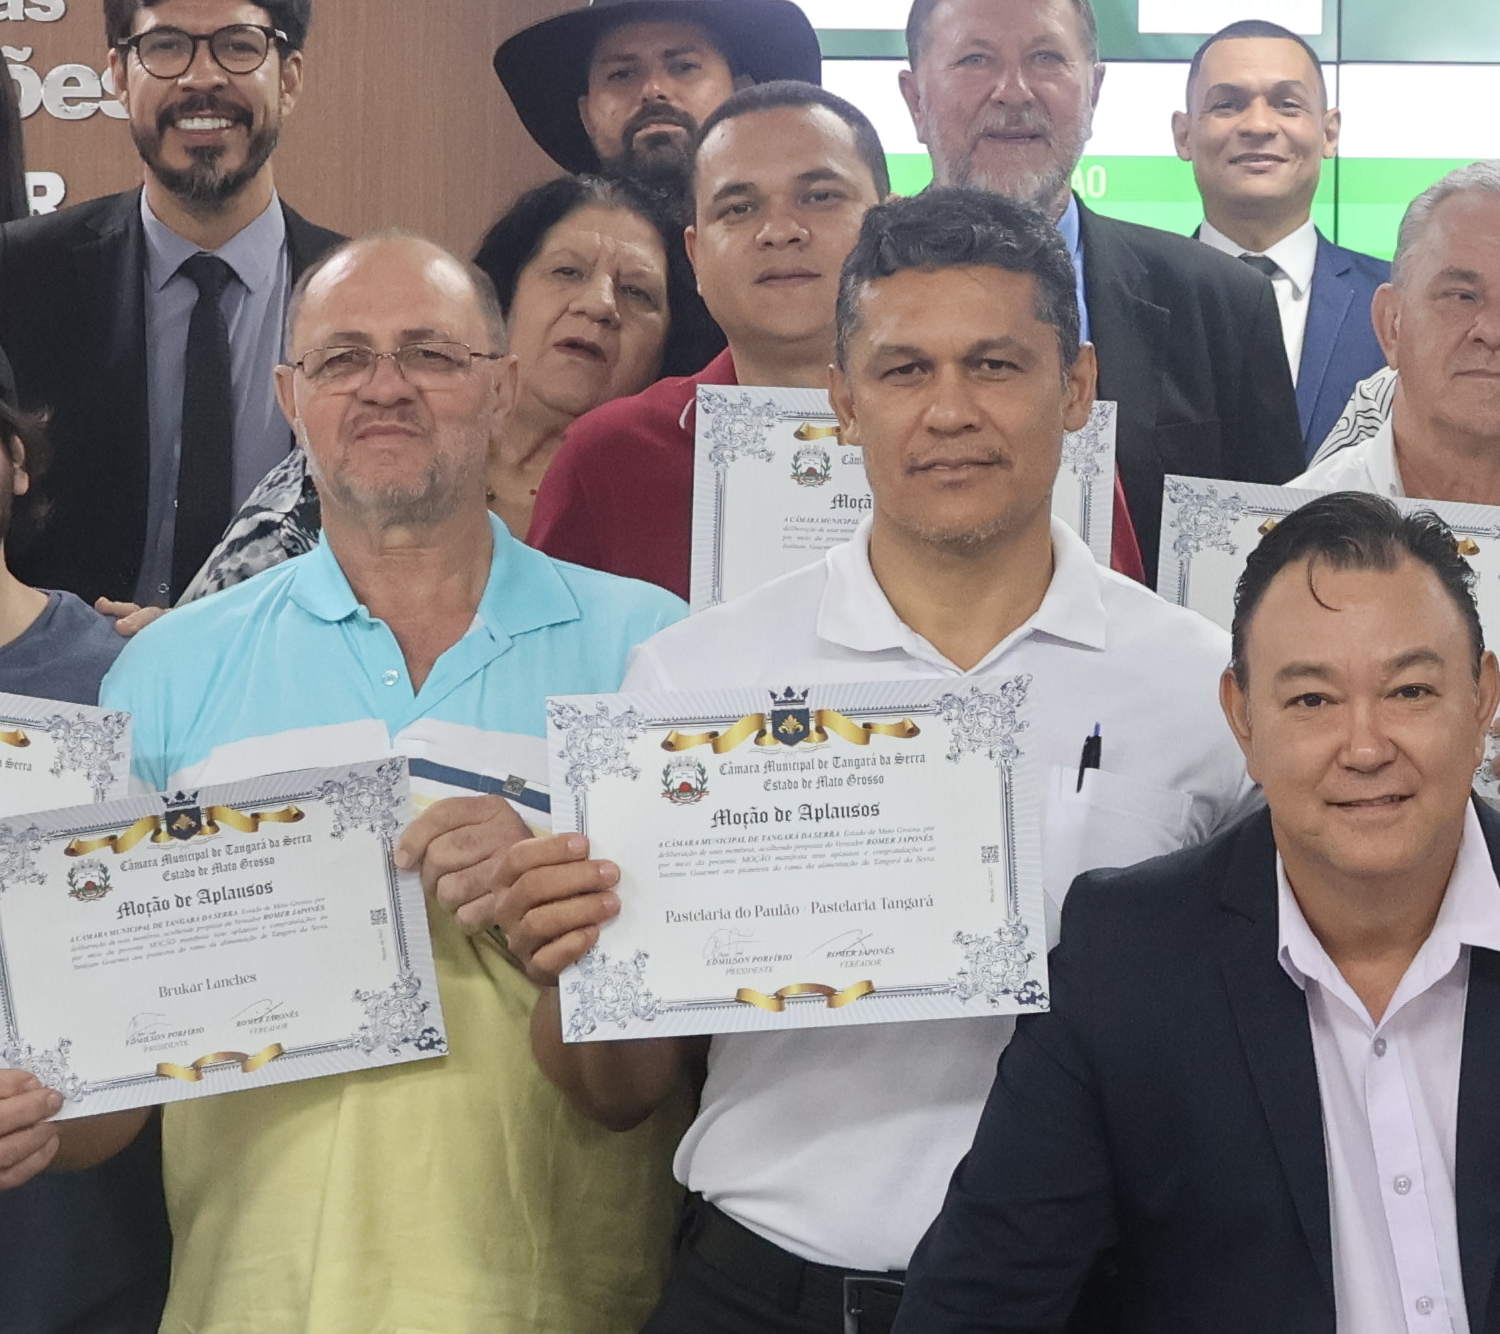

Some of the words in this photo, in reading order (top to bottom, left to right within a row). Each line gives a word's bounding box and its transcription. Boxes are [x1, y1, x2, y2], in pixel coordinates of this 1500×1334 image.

[830, 493, 872, 511] Moçã
[718, 761, 760, 776] Câmara
[763, 758, 815, 775] Municipal
[817, 758, 829, 770] de
[832, 752, 877, 770] Tangará
[879, 754, 891, 766] da
[894, 752, 926, 765] Serra
[763, 778, 799, 792] Estado
[801, 777, 813, 789] de
[815, 775, 844, 790] Mato
[846, 773, 885, 787] Grosso
[710, 806, 769, 829] Moção
[774, 806, 793, 823] de
[797, 802, 880, 823] Aplausos
[116, 896, 170, 920] Moção
[174, 893, 192, 908] de
[196, 880, 274, 905] Aplausos
[665, 908, 732, 924] Pastelaria
[734, 906, 752, 919] do
[755, 903, 800, 918] Paulão
[811, 899, 877, 914] Pastelaria
[882, 894, 934, 912] Tangará
[158, 982, 204, 998] Brukar
[205, 973, 257, 990] Lanches
